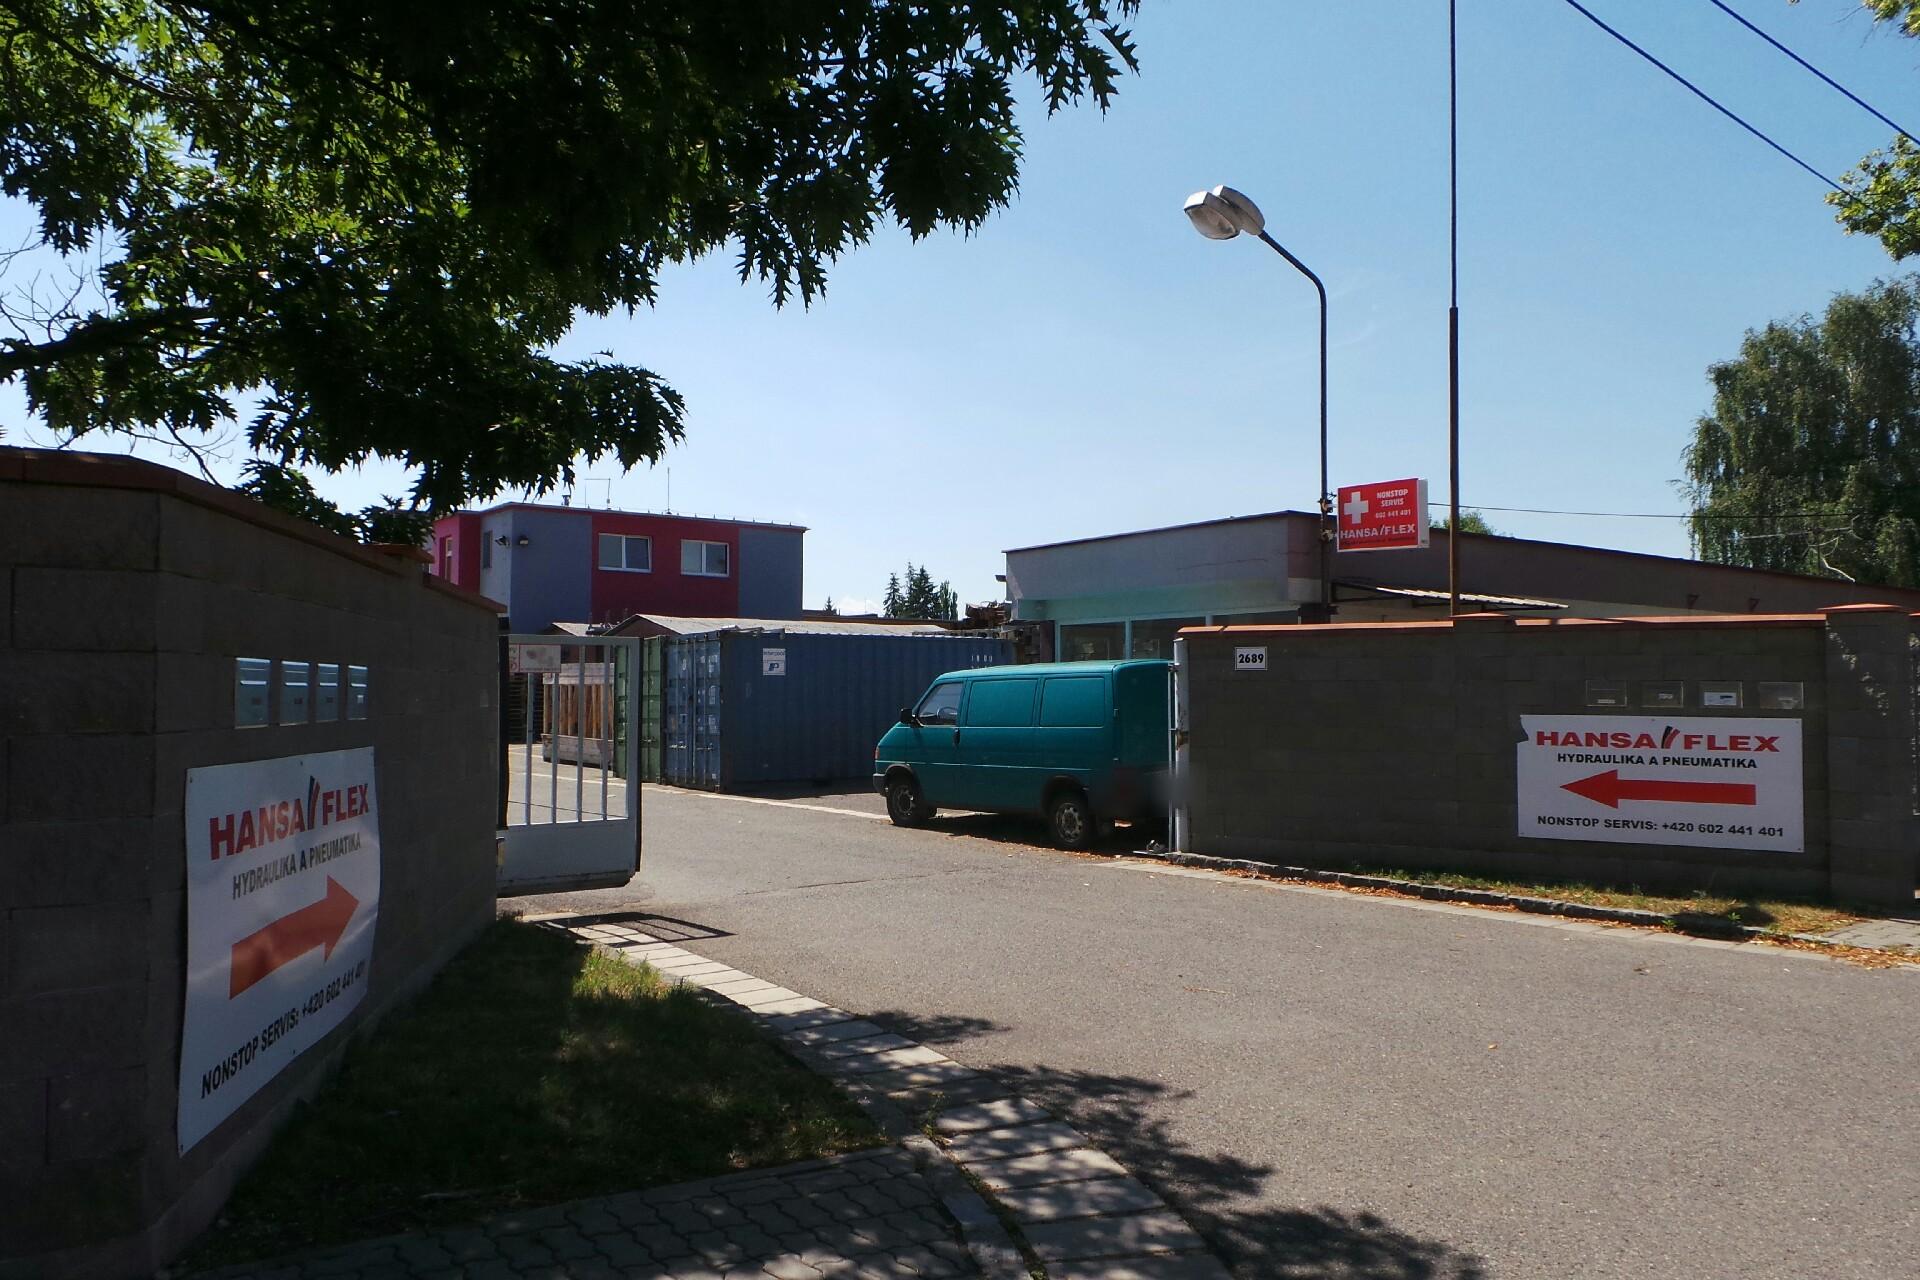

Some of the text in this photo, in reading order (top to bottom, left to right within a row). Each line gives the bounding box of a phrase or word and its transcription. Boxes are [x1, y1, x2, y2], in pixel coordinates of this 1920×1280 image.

[1376, 489, 1409, 499] NONSTOP
[1381, 498, 1404, 507] SERVIS
[1238, 653, 1264, 664] 2689
[1557, 753, 1758, 768] HYDRAULIKA A PNEUMATIKA
[1537, 815, 1783, 837] NONSTOP SERVIS: +420 602 441 401
[232, 832, 361, 900] HYDRAULIKA A PNEUMATIKA
[201, 1036, 259, 1099] NONSTOP
[261, 1008, 300, 1052] SERVIS:
[302, 989, 324, 1017] +420
[326, 977, 341, 1004] 602
[342, 968, 354, 990] 441
